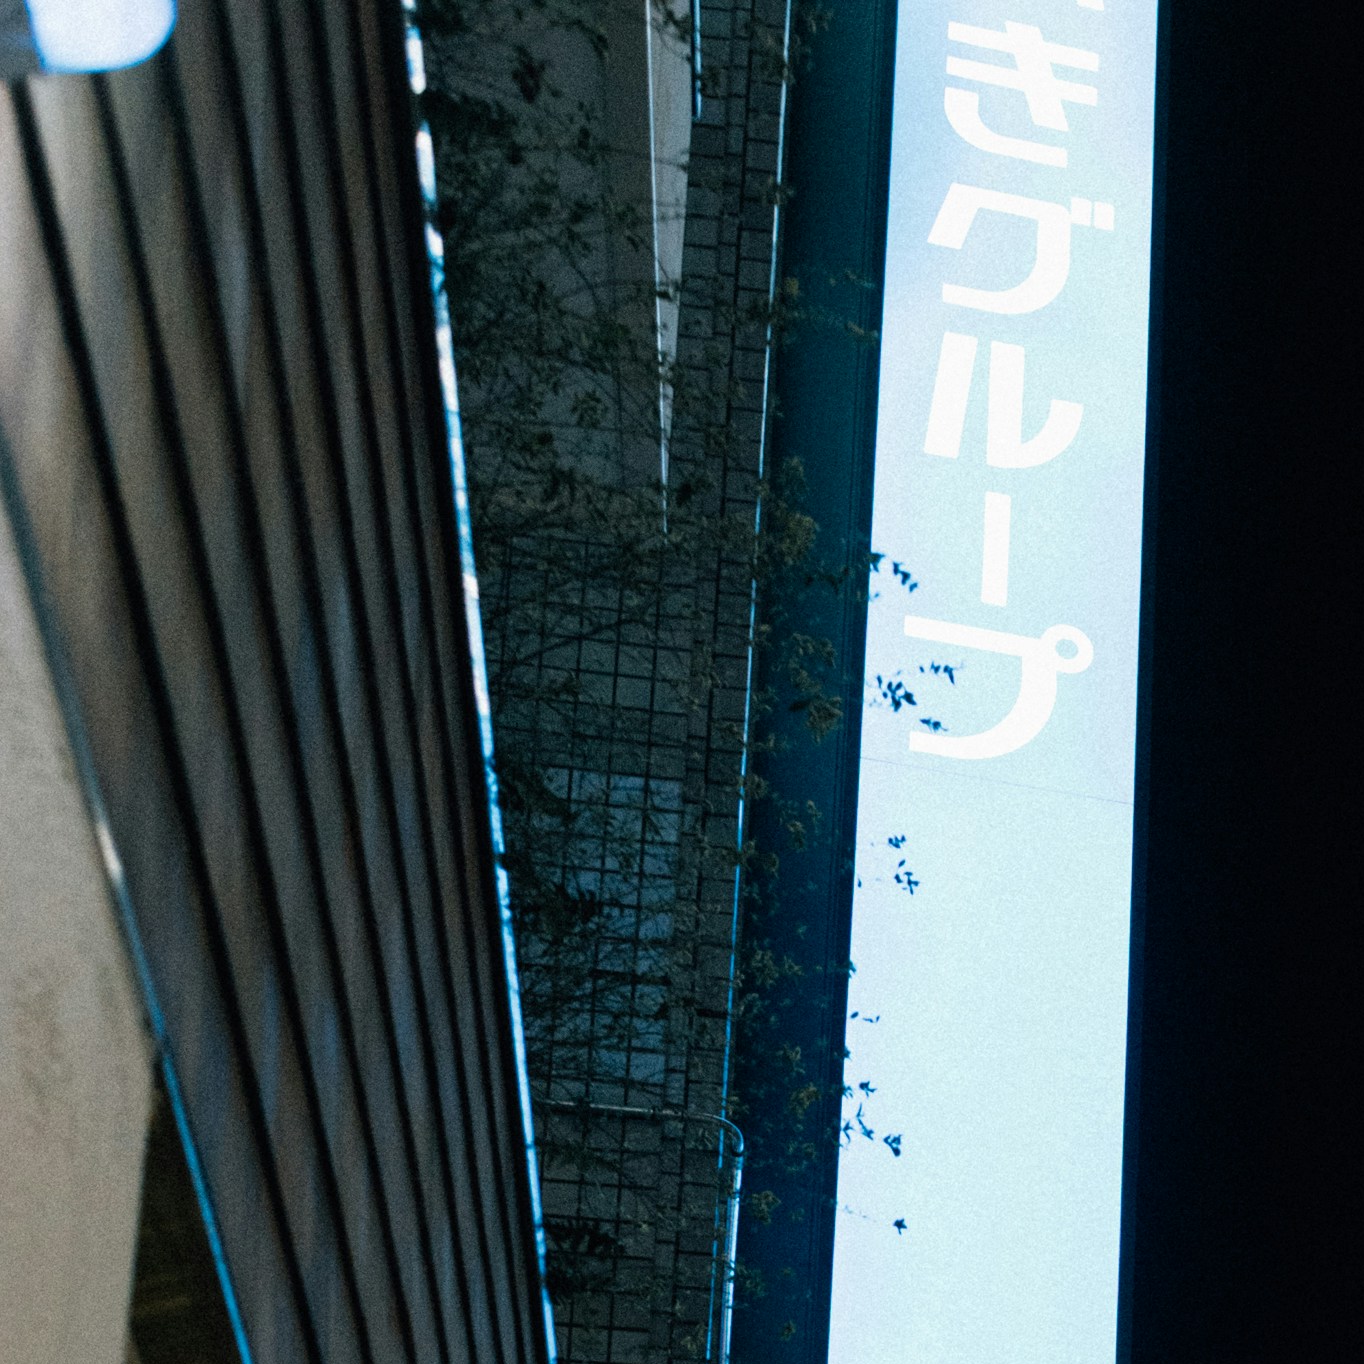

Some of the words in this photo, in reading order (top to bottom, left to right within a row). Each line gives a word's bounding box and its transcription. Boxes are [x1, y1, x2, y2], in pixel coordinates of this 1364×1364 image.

[903, 0, 1115, 760] きグループ
